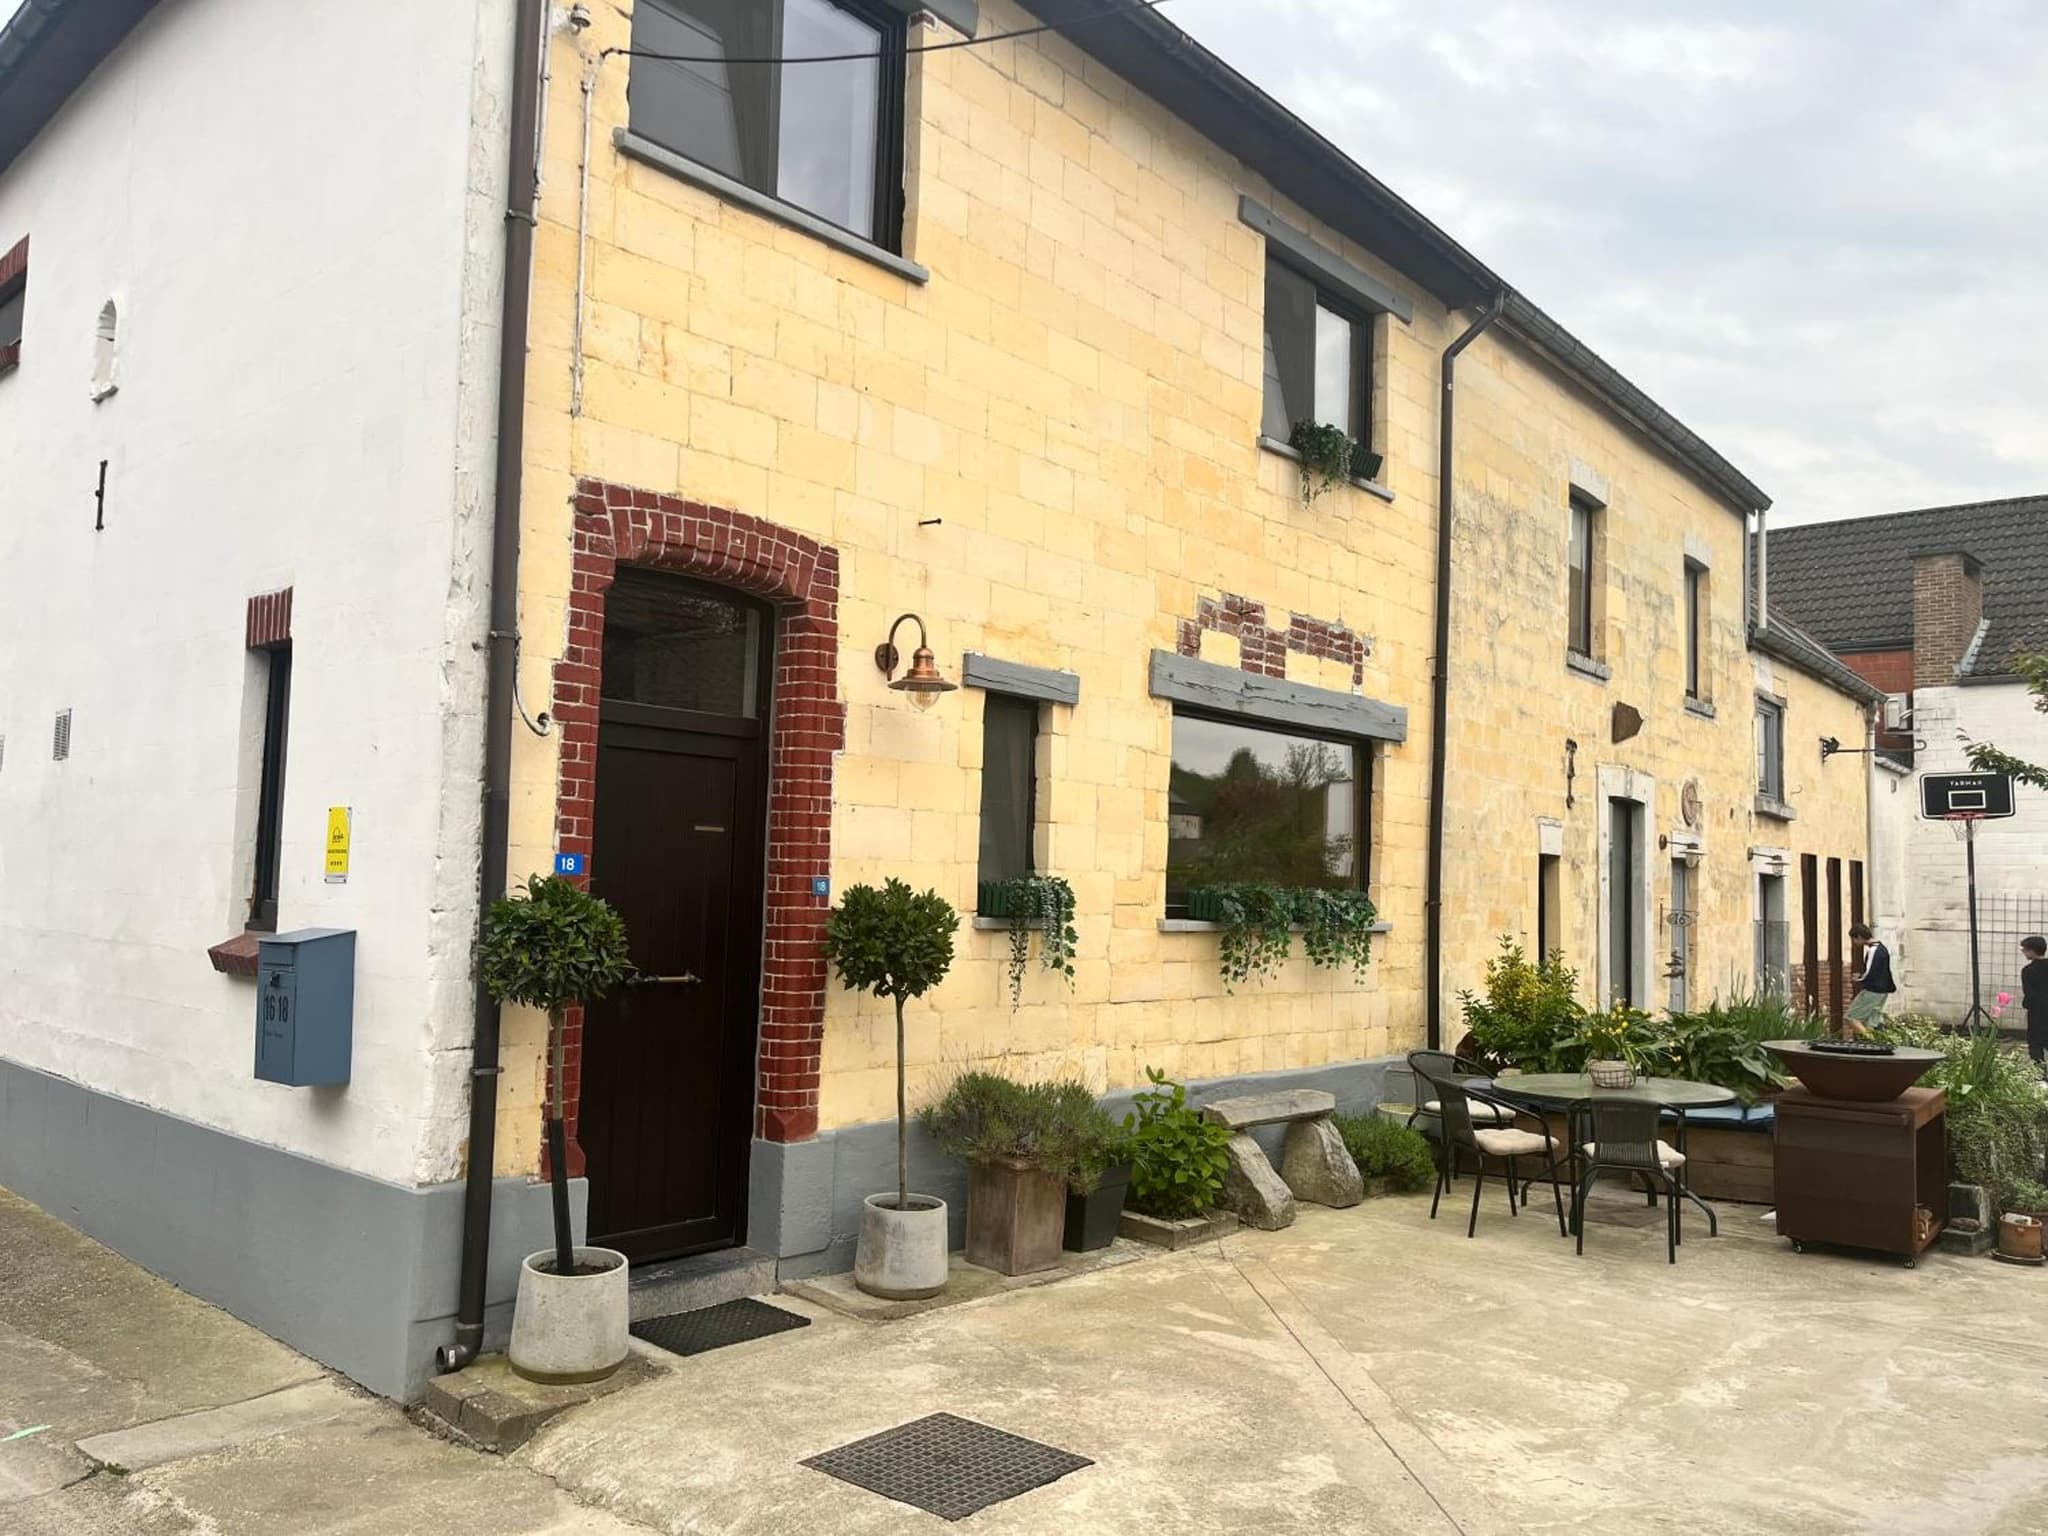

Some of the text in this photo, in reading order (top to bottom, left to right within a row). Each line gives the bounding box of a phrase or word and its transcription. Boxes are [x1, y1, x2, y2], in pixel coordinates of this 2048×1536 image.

[562, 857, 575, 870] 18
[1674, 913, 1686, 925] 16
[264, 995, 289, 1023] 16 18
